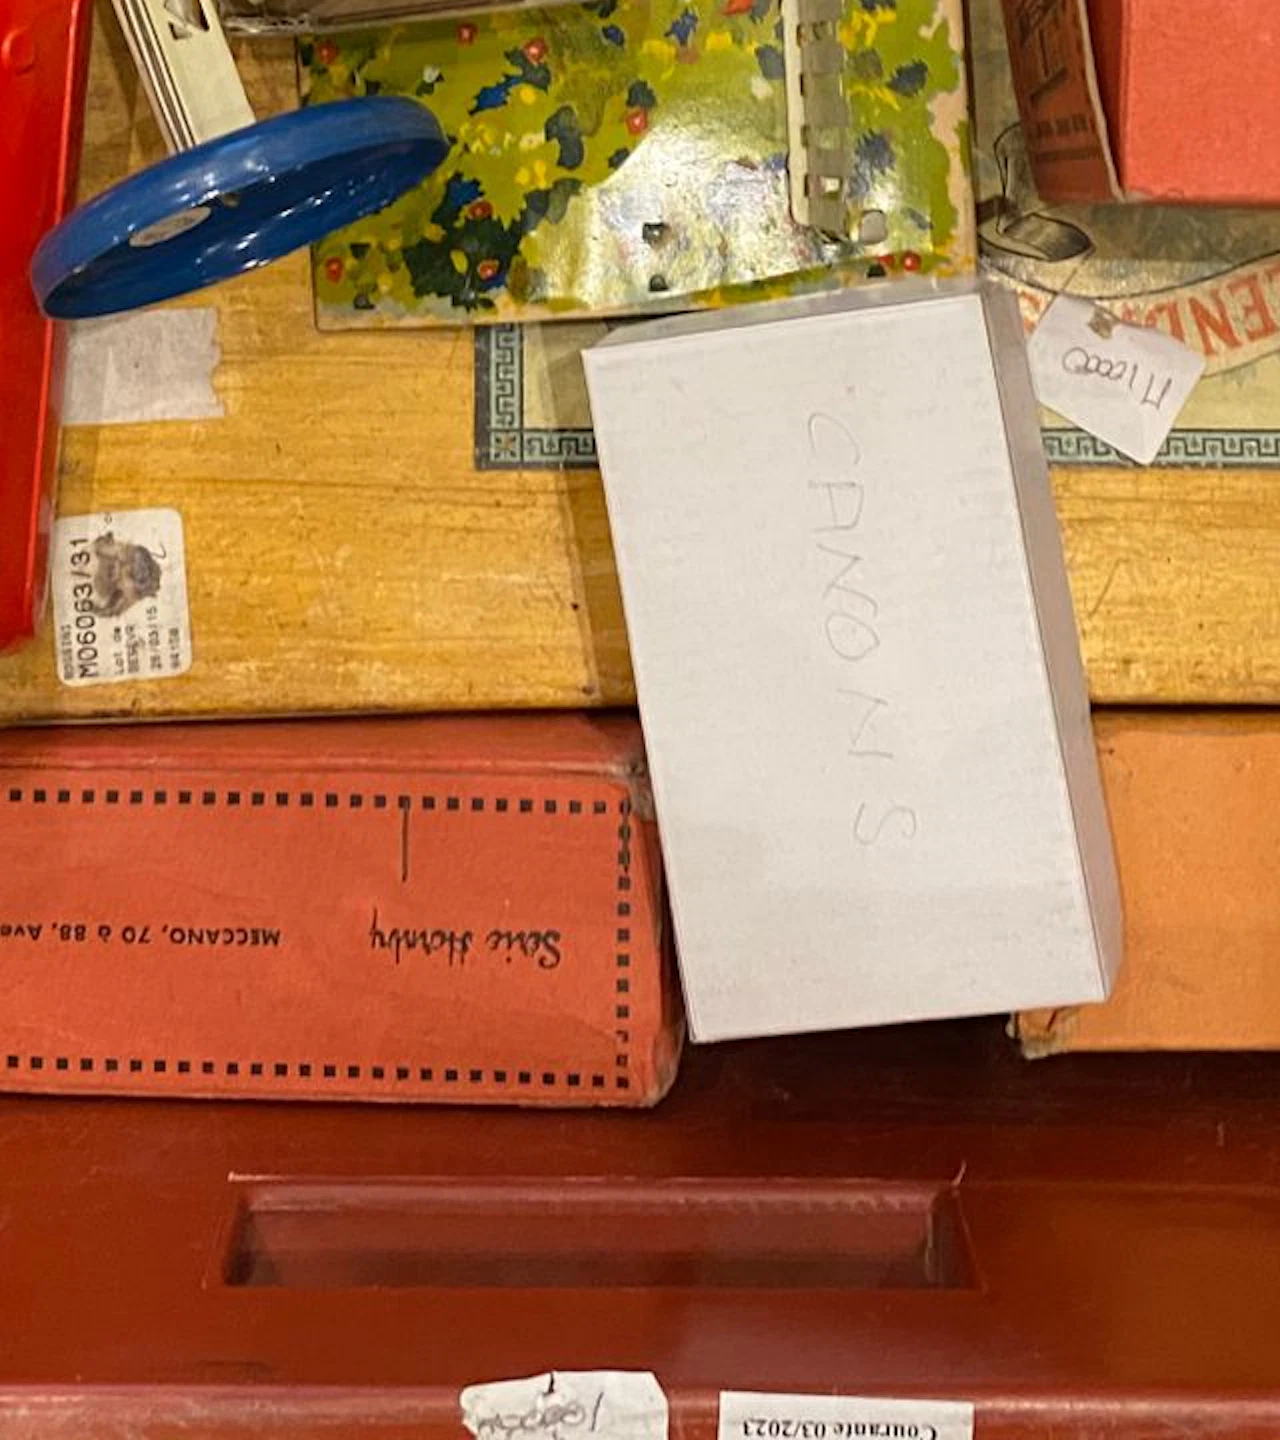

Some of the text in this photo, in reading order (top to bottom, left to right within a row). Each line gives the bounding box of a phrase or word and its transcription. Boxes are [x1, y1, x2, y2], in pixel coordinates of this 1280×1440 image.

[69, 537, 99, 679] M06063/31
[51, 923, 87, 942] 88,
[121, 925, 152, 945] 70
[161, 924, 282, 947] MECCANO,
[369, 907, 473, 967] Hornby
[742, 1418, 827, 1439] 03/2023
